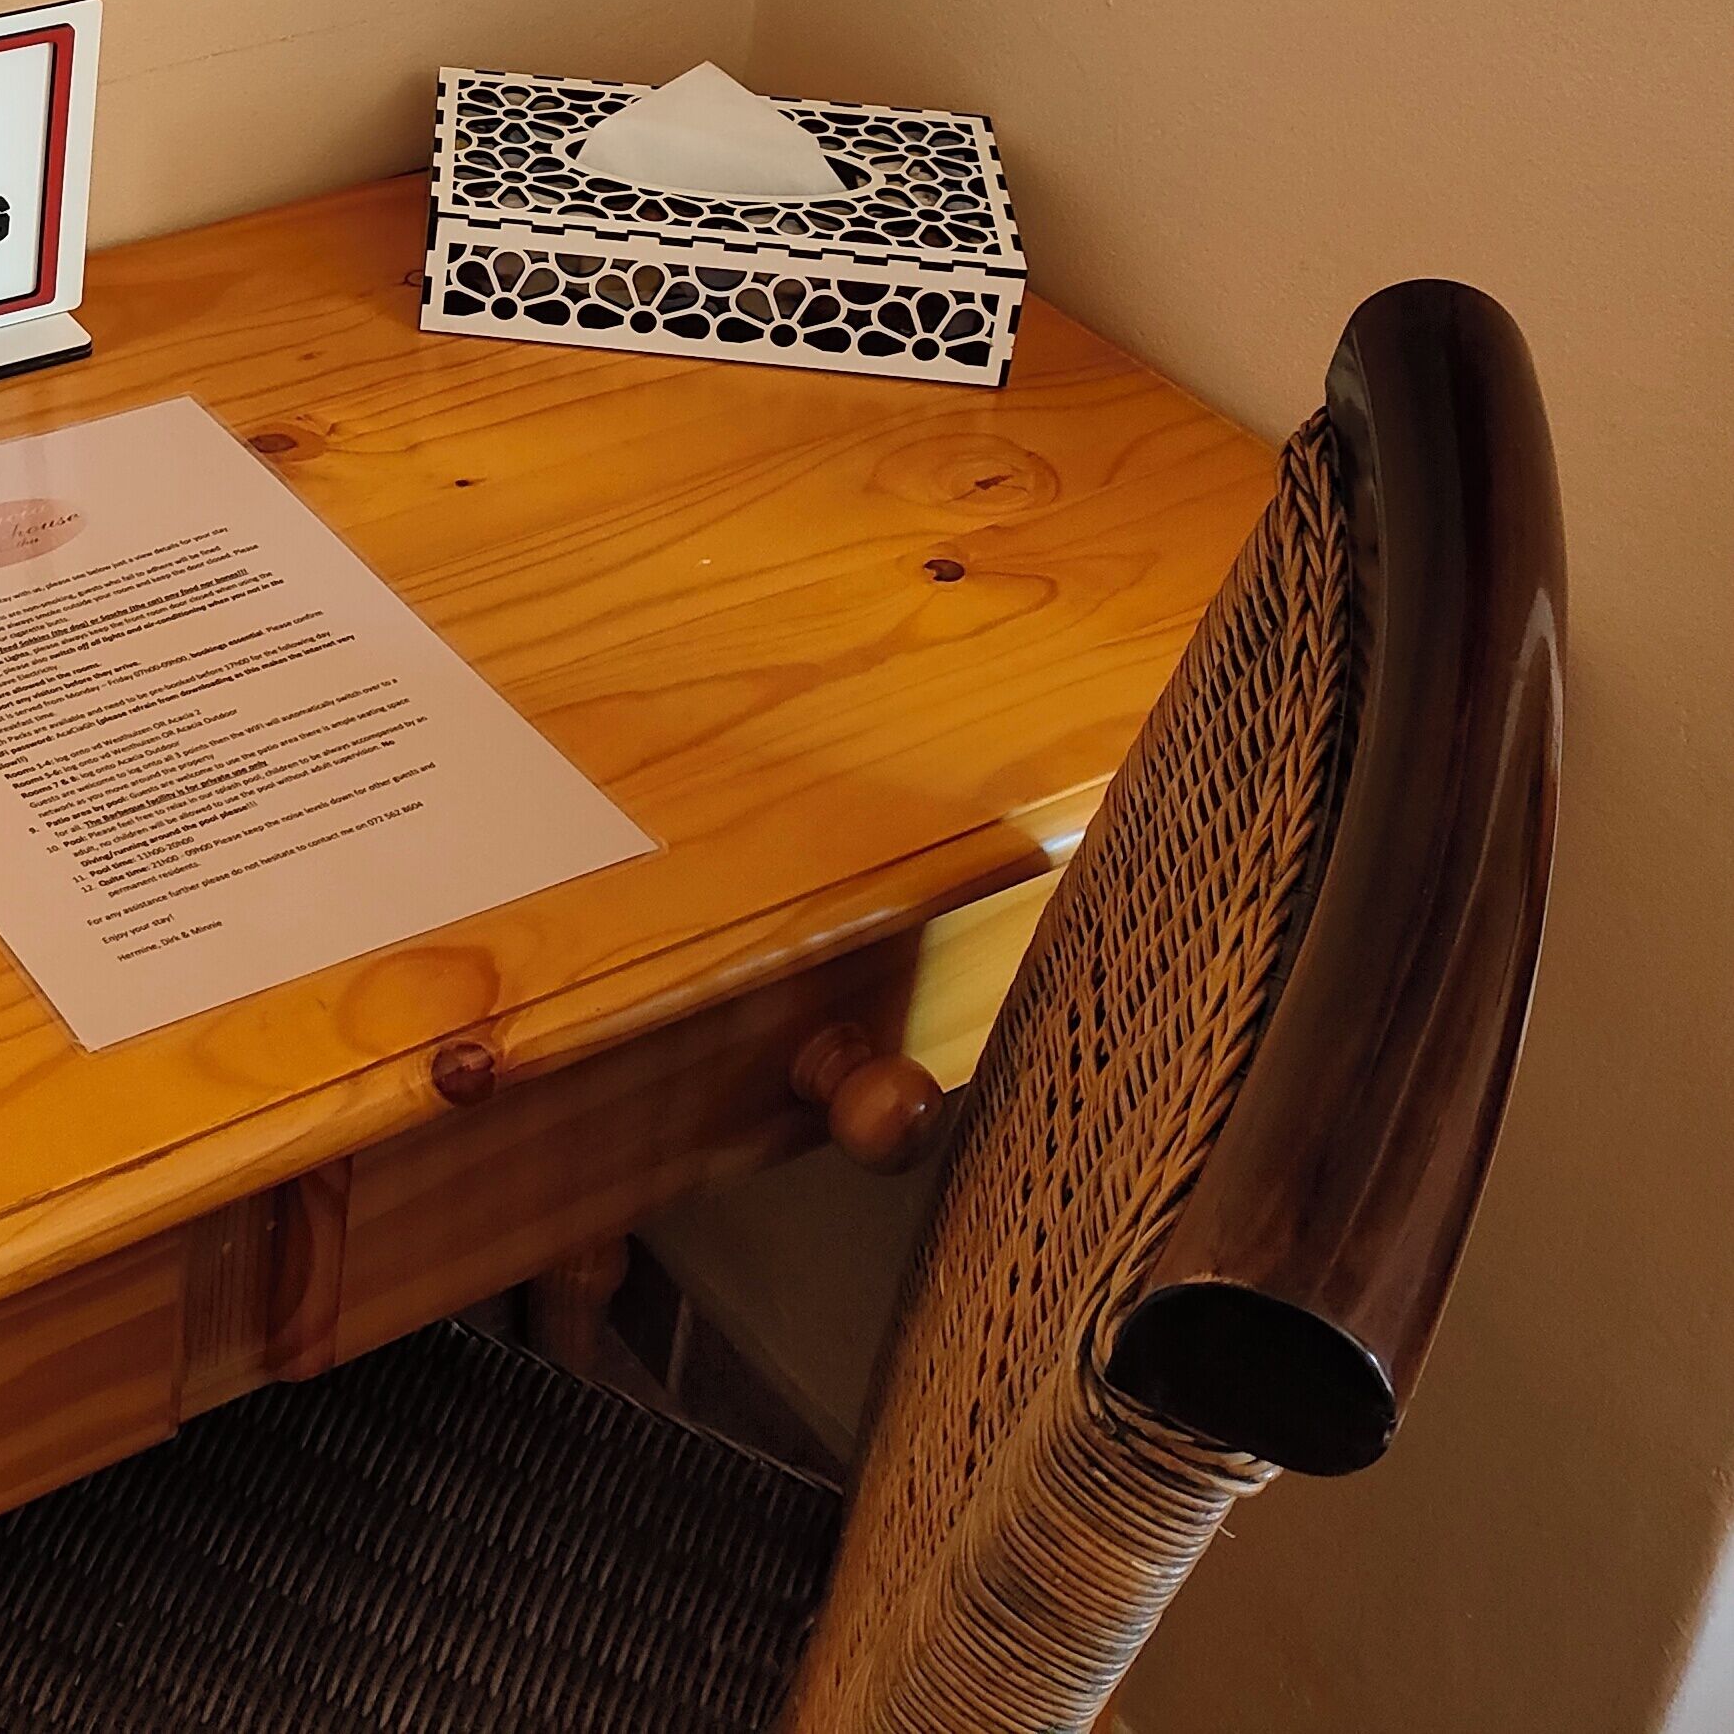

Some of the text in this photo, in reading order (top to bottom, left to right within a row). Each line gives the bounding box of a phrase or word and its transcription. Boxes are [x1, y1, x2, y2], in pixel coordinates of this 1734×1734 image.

[12, 679, 45, 693] allowed
[15, 696, 31, 704] any
[32, 686, 63, 698] visitors
[63, 677, 92, 688] before
[92, 670, 112, 678] they
[4, 766, 35, 779] Rooms
[70, 748, 90, 757] onto
[102, 727, 152, 745] Westhuizen
[152, 721, 166, 729] OR
[167, 712, 194, 723] Acacia
[46, 817, 70, 827] Patio
[72, 809, 91, 819] area
[105, 796, 128, 808] pool:
[129, 785, 159, 798] Guests
[176, 767, 212, 782] welcome
[225, 757, 240, 765] use
[257, 744, 278, 755] patio
[280, 737, 298, 745] area
[298, 729, 321, 739] there
[331, 717, 355, 728] ample
[356, 706, 387, 719] seating
[386, 698, 409, 708] space
[80, 801, 256, 866] Diving/running around the pool please!!!
[87, 917, 102, 925] For
[105, 911, 121, 920] any
[123, 895, 167, 913] assistance
[168, 883, 199, 897] further
[201, 873, 229, 886] please
[244, 861, 260, 870] not
[259, 849, 295, 864] hesitate
[307, 832, 339, 846] contact
[340, 827, 354, 835] me
[366, 815, 383, 825] 072
[383, 809, 401, 819] 562
[89, 865, 111, 876] Pool
[111, 858, 135, 868] time:
[102, 913, 173, 943] Enjoy your stay!
[117, 944, 160, 960] Hermine,
[160, 935, 180, 945] Dirk
[190, 921, 221, 934] Minnie
